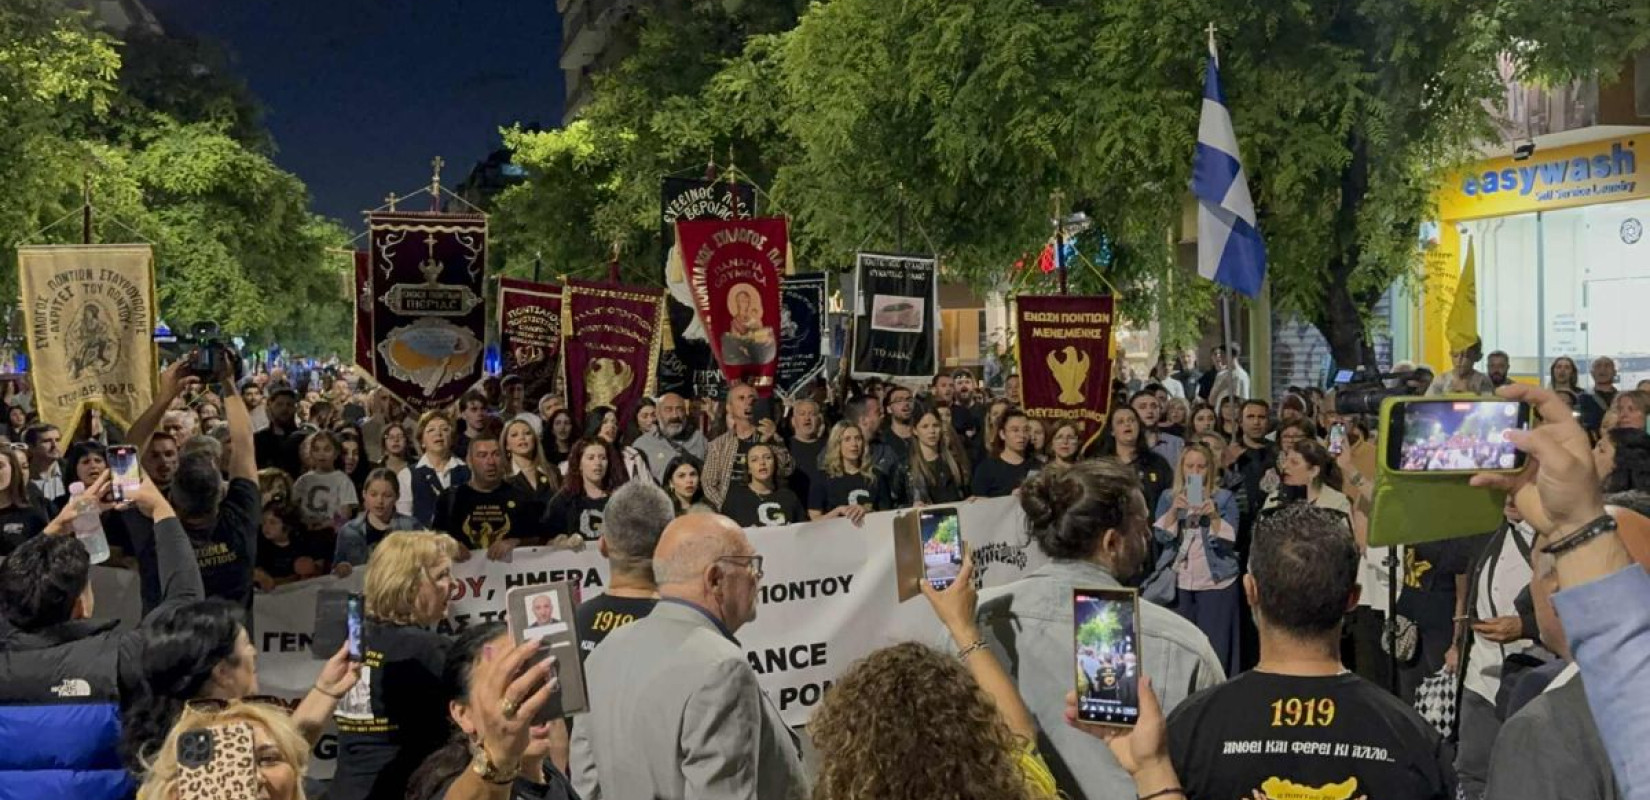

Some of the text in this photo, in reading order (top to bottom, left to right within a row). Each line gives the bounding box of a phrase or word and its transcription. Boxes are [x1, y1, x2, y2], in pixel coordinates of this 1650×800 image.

[1463, 142, 1637, 196] easywash
[713, 227, 768, 251] ΣΥΛΛΟΓΟΣ
[81, 283, 104, 295] ΤΟΥ
[34, 268, 147, 351] ΣΥΛΛΟΓΟΣ ΠΟΝΤΙΩΝ ΣΤΑΥΡΟΥΠΟΛΗΣ
[1023, 311, 1110, 324] ΕΝΩΣΗ ΠΟΝΤΙΩΝ
[1032, 327, 1102, 339] ΜΕΝΕΜΕΝΗΣ
[309, 486, 333, 512] G
[579, 508, 604, 538] G
[757, 502, 786, 526] G
[1271, 698, 1336, 726] 1919
[1265, 740, 1288, 754] ΚΑΙ
[1291, 741, 1332, 755] ΦΕΡΕΙ
[1334, 743, 1349, 757] ΚΙ
